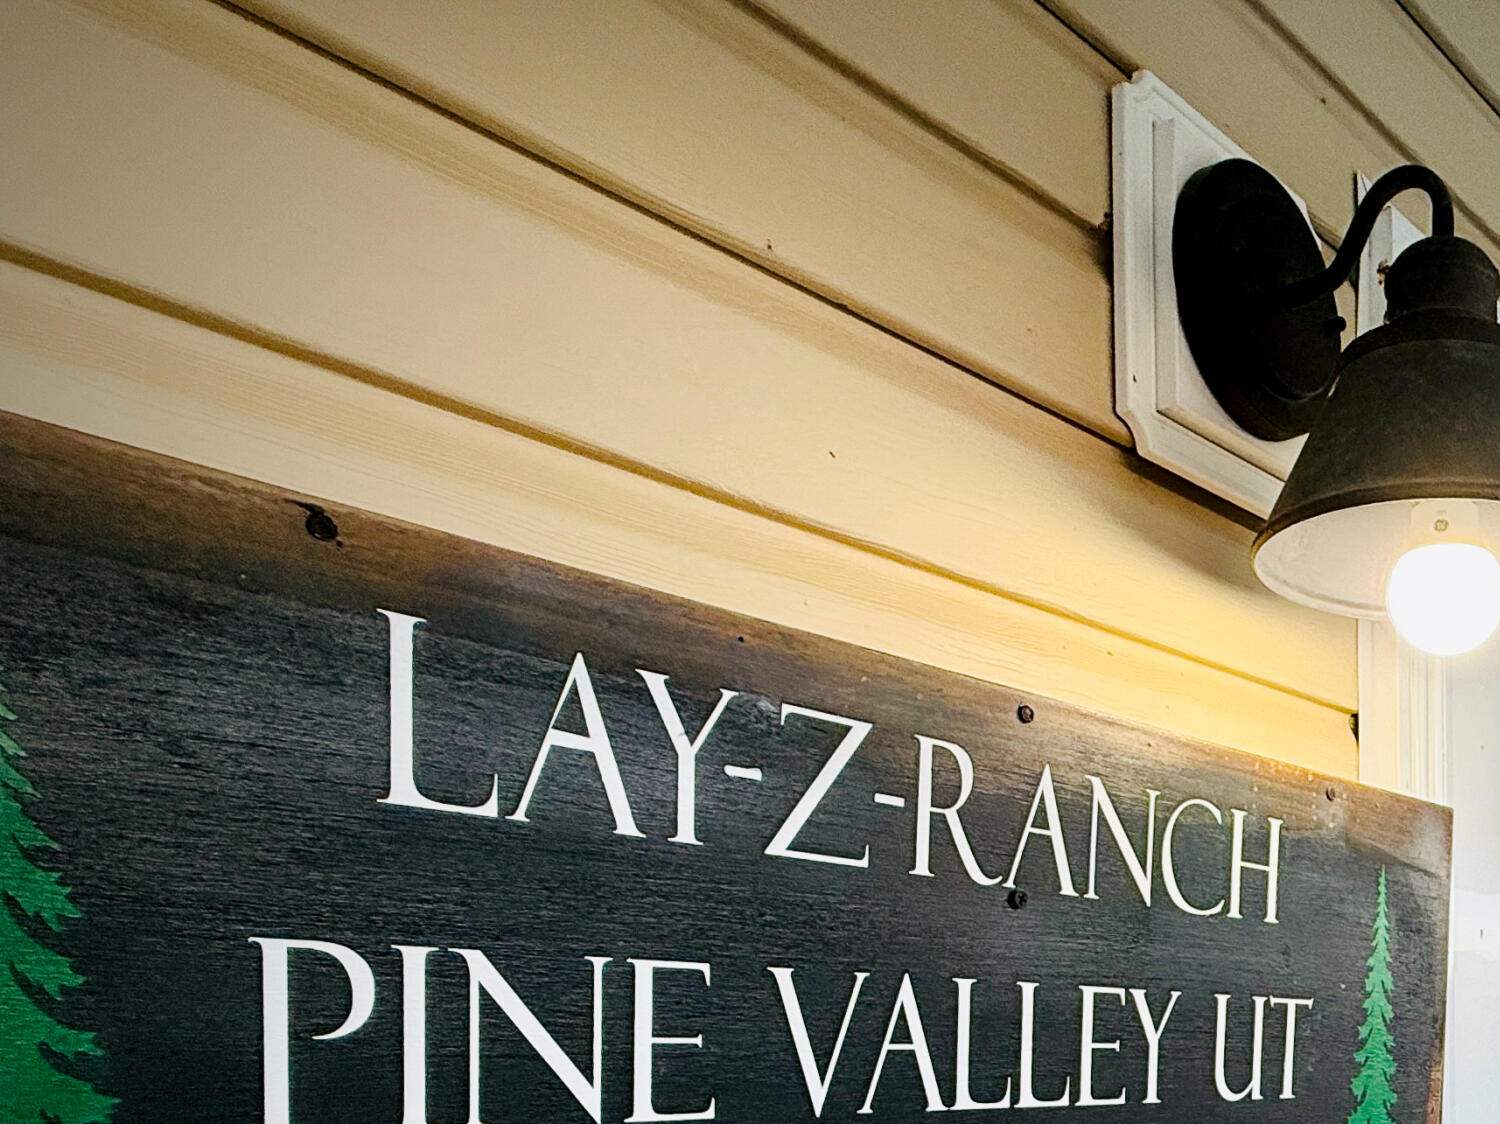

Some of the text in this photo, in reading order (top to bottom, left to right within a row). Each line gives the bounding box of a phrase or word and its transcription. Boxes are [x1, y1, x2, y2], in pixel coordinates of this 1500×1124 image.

[376, 608, 1284, 925] LAY-Z-RANCH
[766, 966, 1182, 1118] VALLEY
[1213, 993, 1315, 1102] UT
